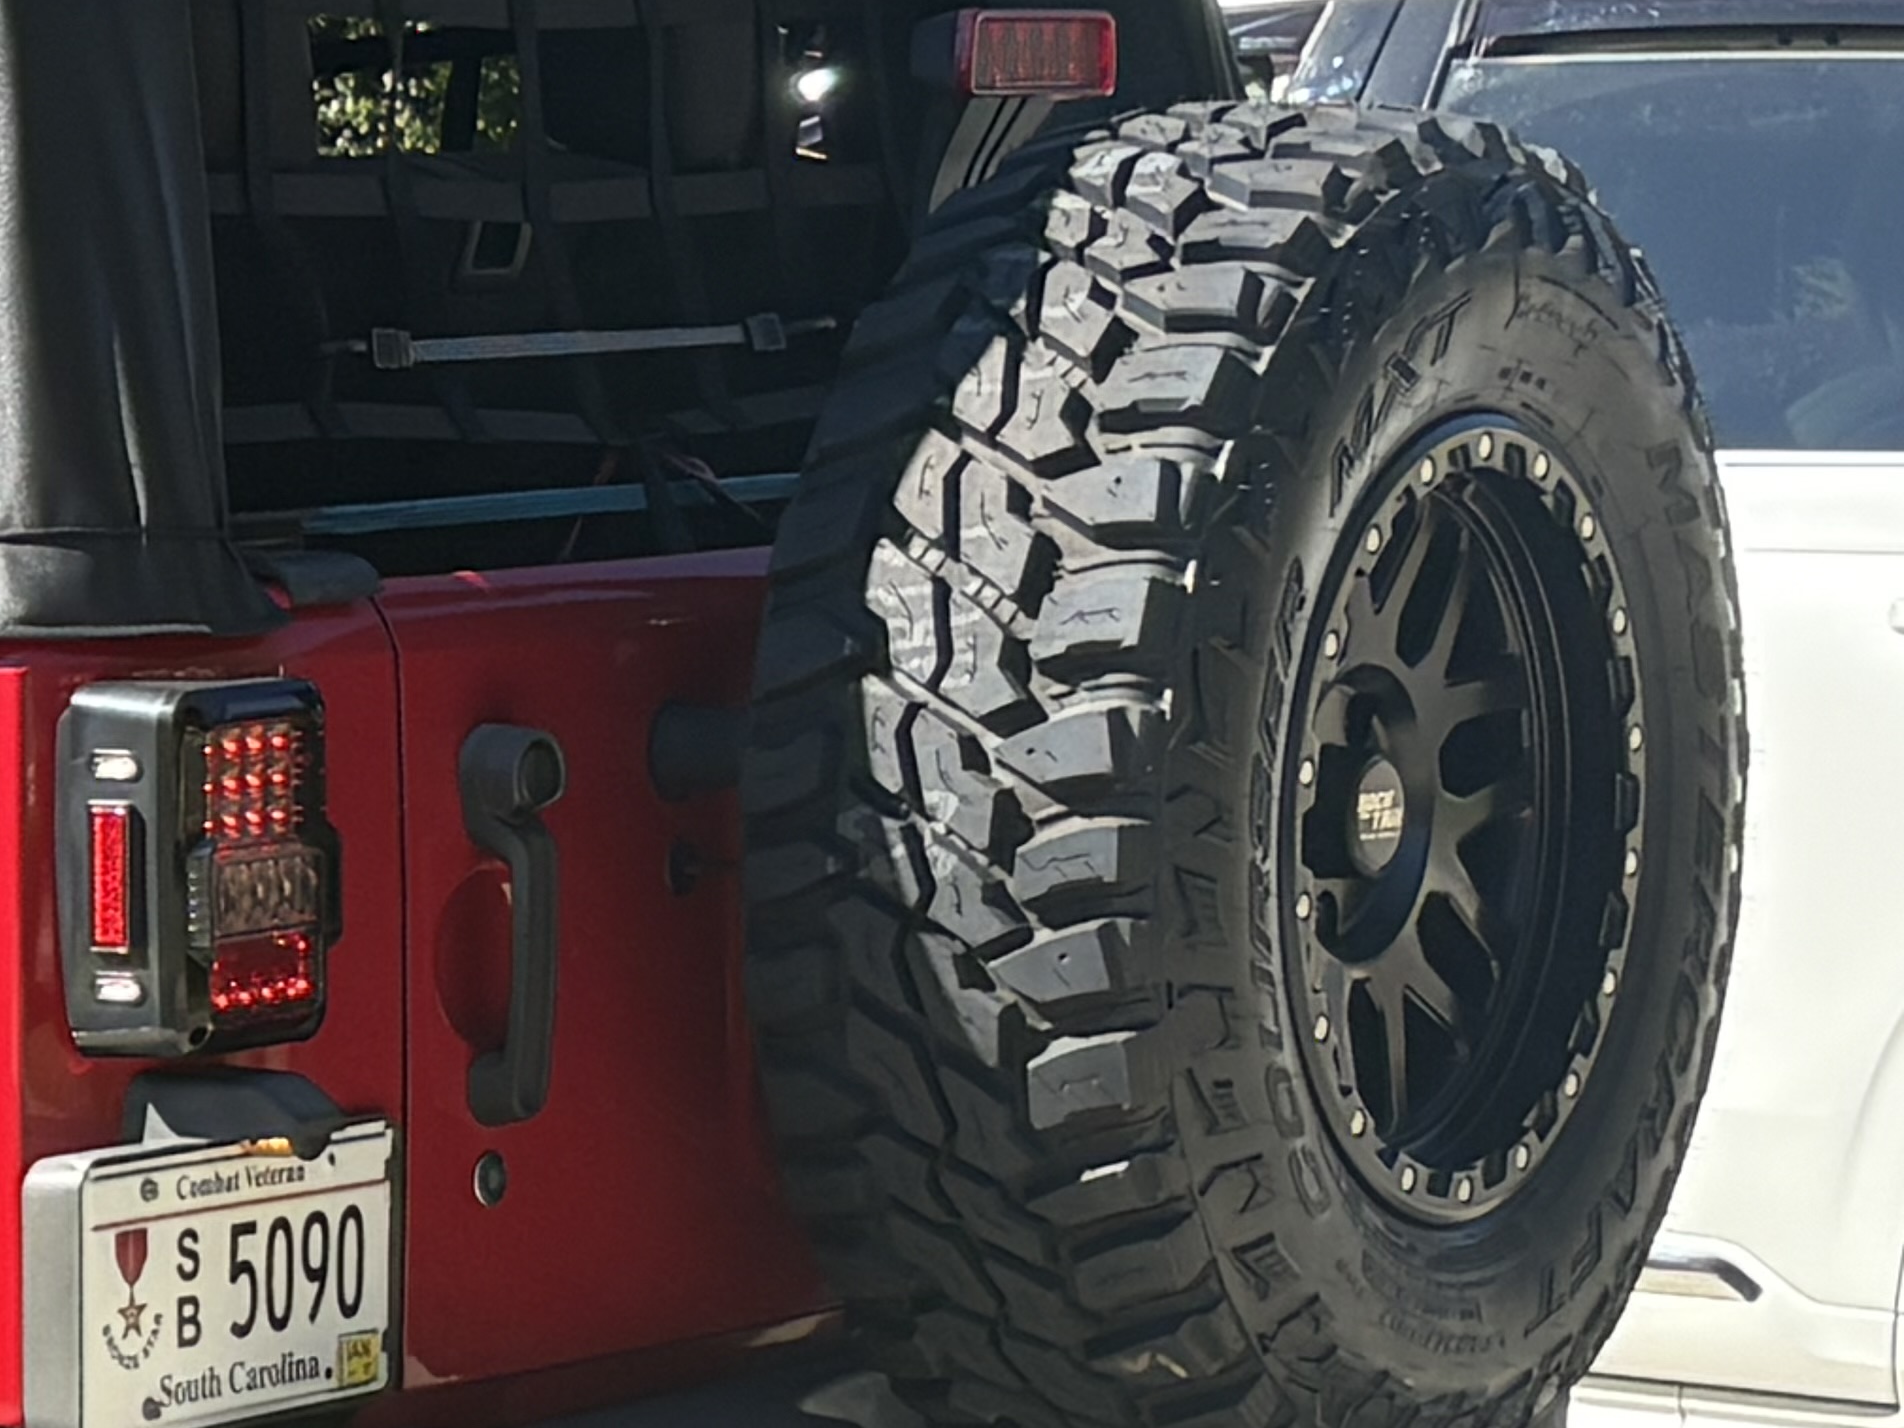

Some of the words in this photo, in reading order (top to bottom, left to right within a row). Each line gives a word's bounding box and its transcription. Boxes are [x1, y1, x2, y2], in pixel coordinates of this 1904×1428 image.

[176, 1170, 240, 1201] Combat
[244, 1164, 306, 1188] Veteran
[175, 1227, 201, 1281] S
[228, 1204, 365, 1339] 5090
[176, 1294, 202, 1348] B
[158, 1365, 222, 1408] South
[228, 1350, 321, 1395] Carolina
